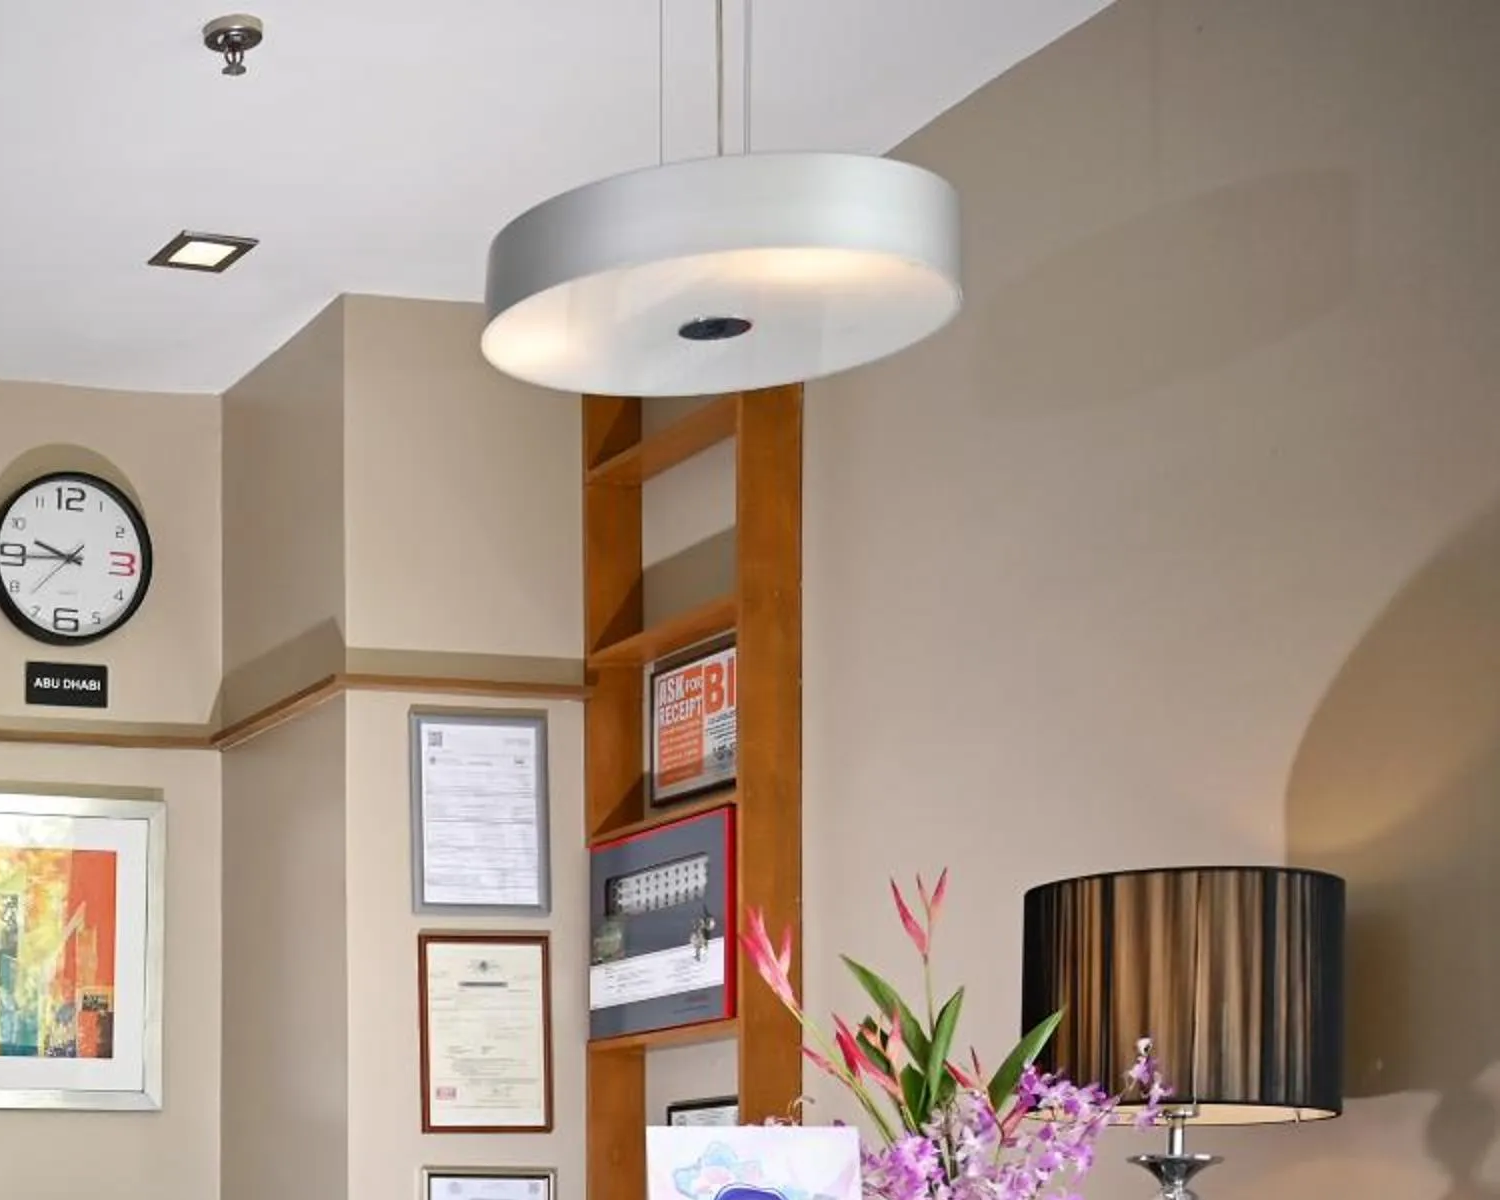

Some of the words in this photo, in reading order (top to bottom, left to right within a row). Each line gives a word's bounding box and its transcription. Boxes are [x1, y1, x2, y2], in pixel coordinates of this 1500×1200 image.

[35, 496, 45, 509] 11
[56, 487, 87, 512] 12
[115, 526, 125, 539] 2
[0, 543, 26, 567] 9
[107, 551, 136, 577] 3
[9, 580, 21, 593] 8
[114, 589, 124, 601] 4
[53, 607, 79, 632] 6
[92, 612, 101, 625] 5
[34, 677, 60, 689] ABU
[63, 678, 101, 691] DHABI
[659, 674, 685, 706] ASK
[659, 696, 703, 726] RECEIPT
